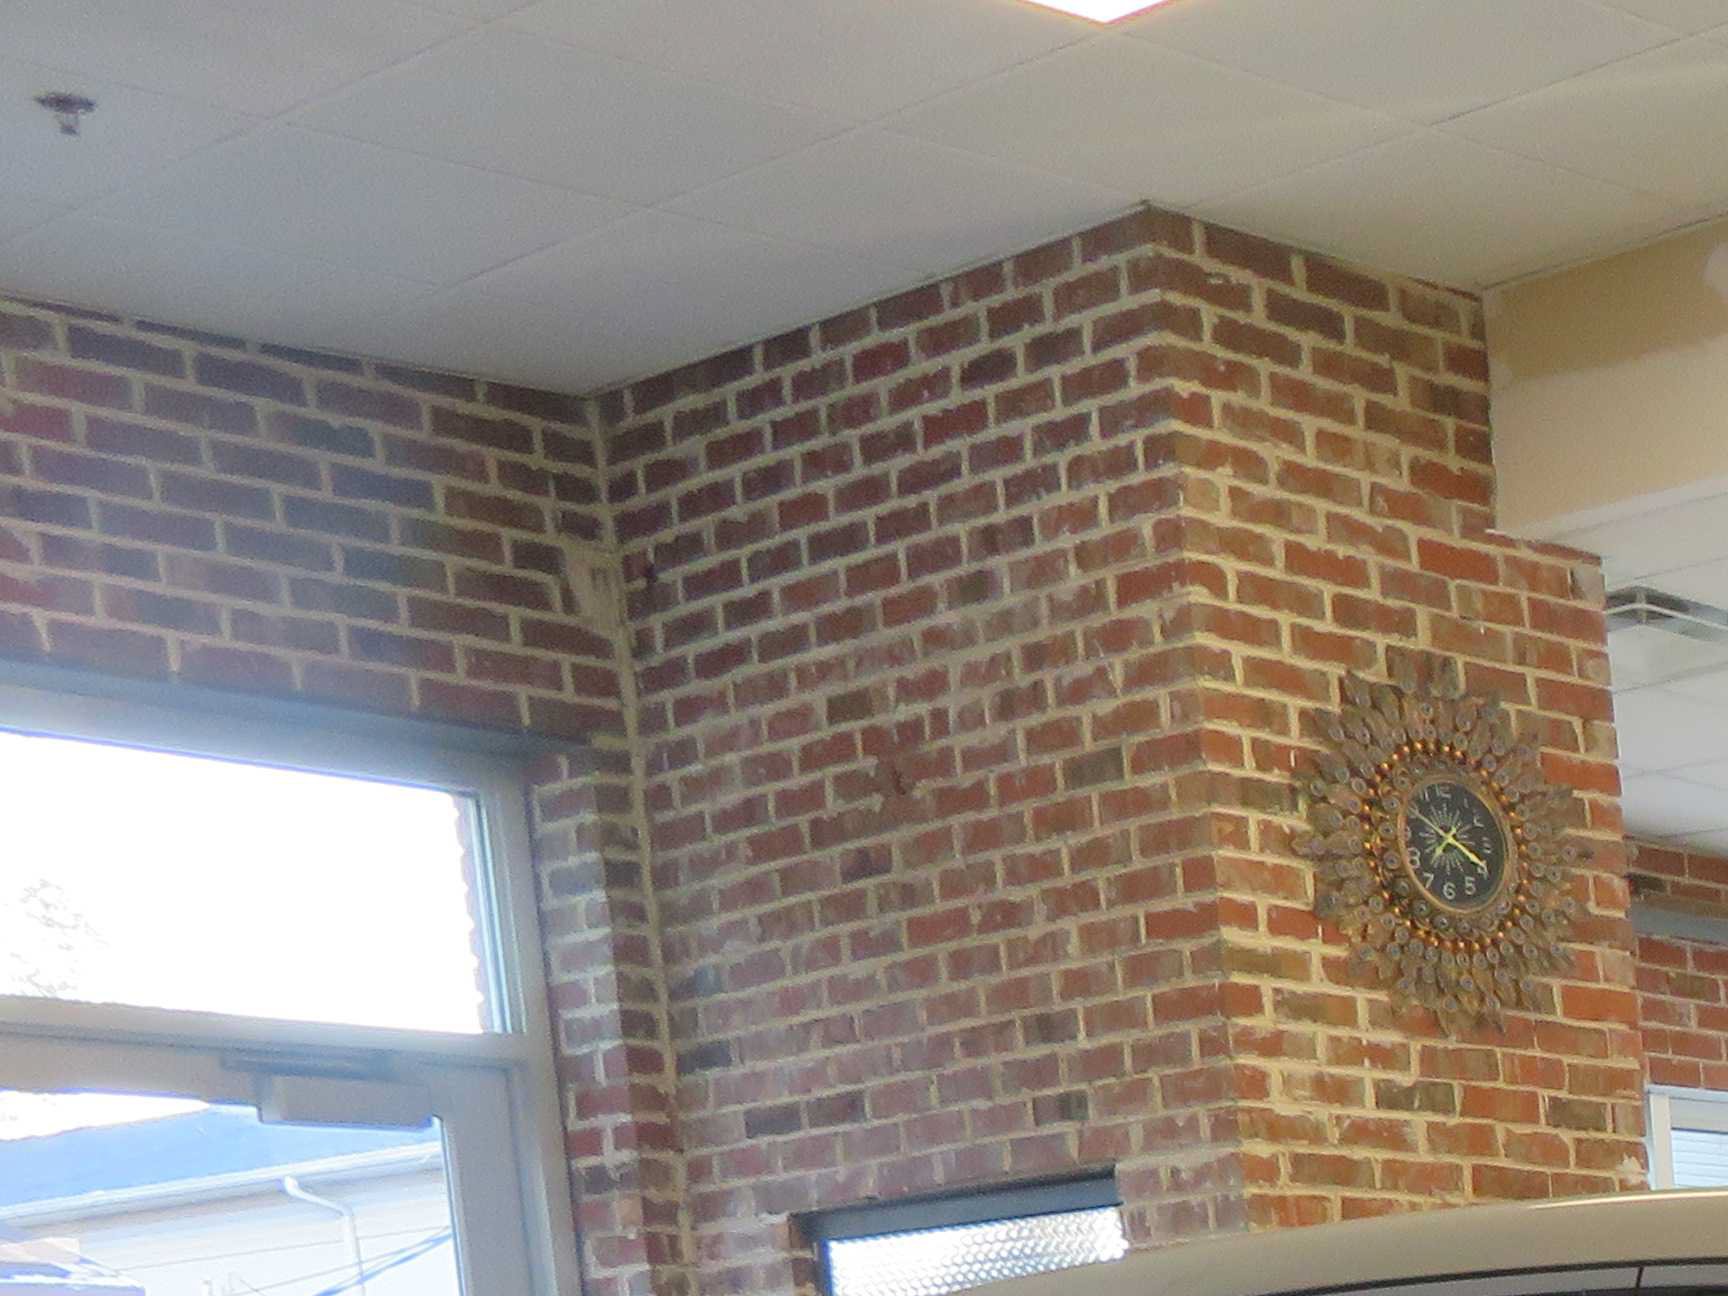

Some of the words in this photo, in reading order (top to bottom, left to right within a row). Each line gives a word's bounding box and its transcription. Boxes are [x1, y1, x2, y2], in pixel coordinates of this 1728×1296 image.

[1423, 872, 1434, 889] 7
[1464, 876, 1476, 896] 5
[1442, 882, 1455, 900] 6
